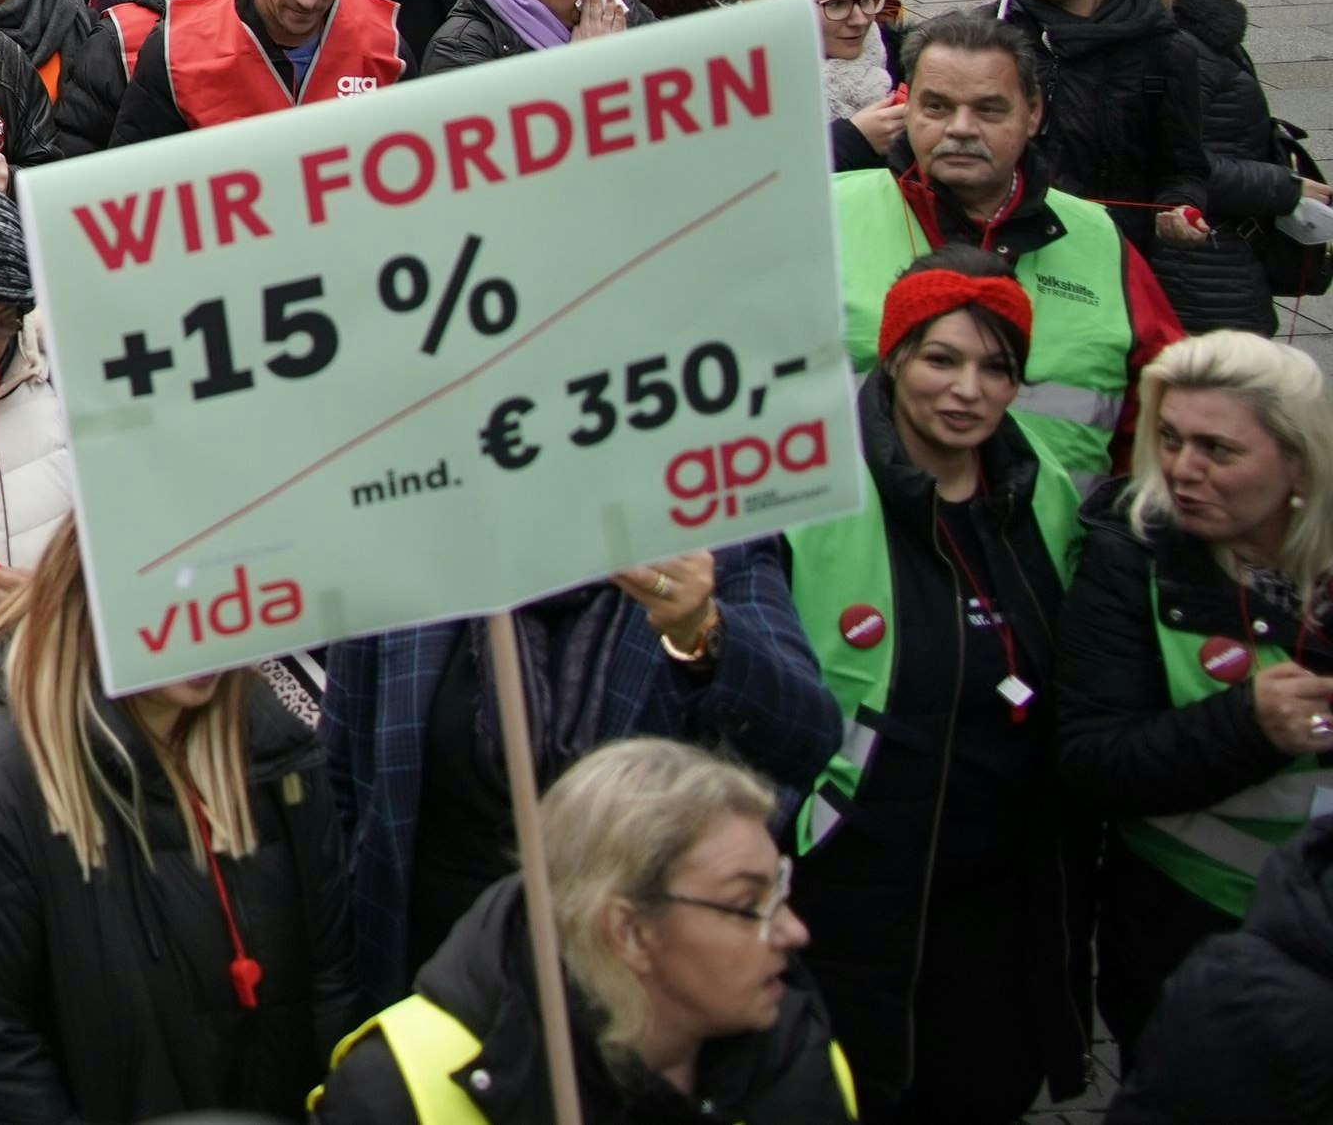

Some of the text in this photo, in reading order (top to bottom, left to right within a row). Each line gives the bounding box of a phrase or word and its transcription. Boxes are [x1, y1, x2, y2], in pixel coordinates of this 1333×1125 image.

[71, 46, 772, 273] WIR FORDERN
[102, 231, 519, 402] +15 %
[349, 339, 809, 508] mind. € 350,-
[138, 419, 828, 653] vida gpa
